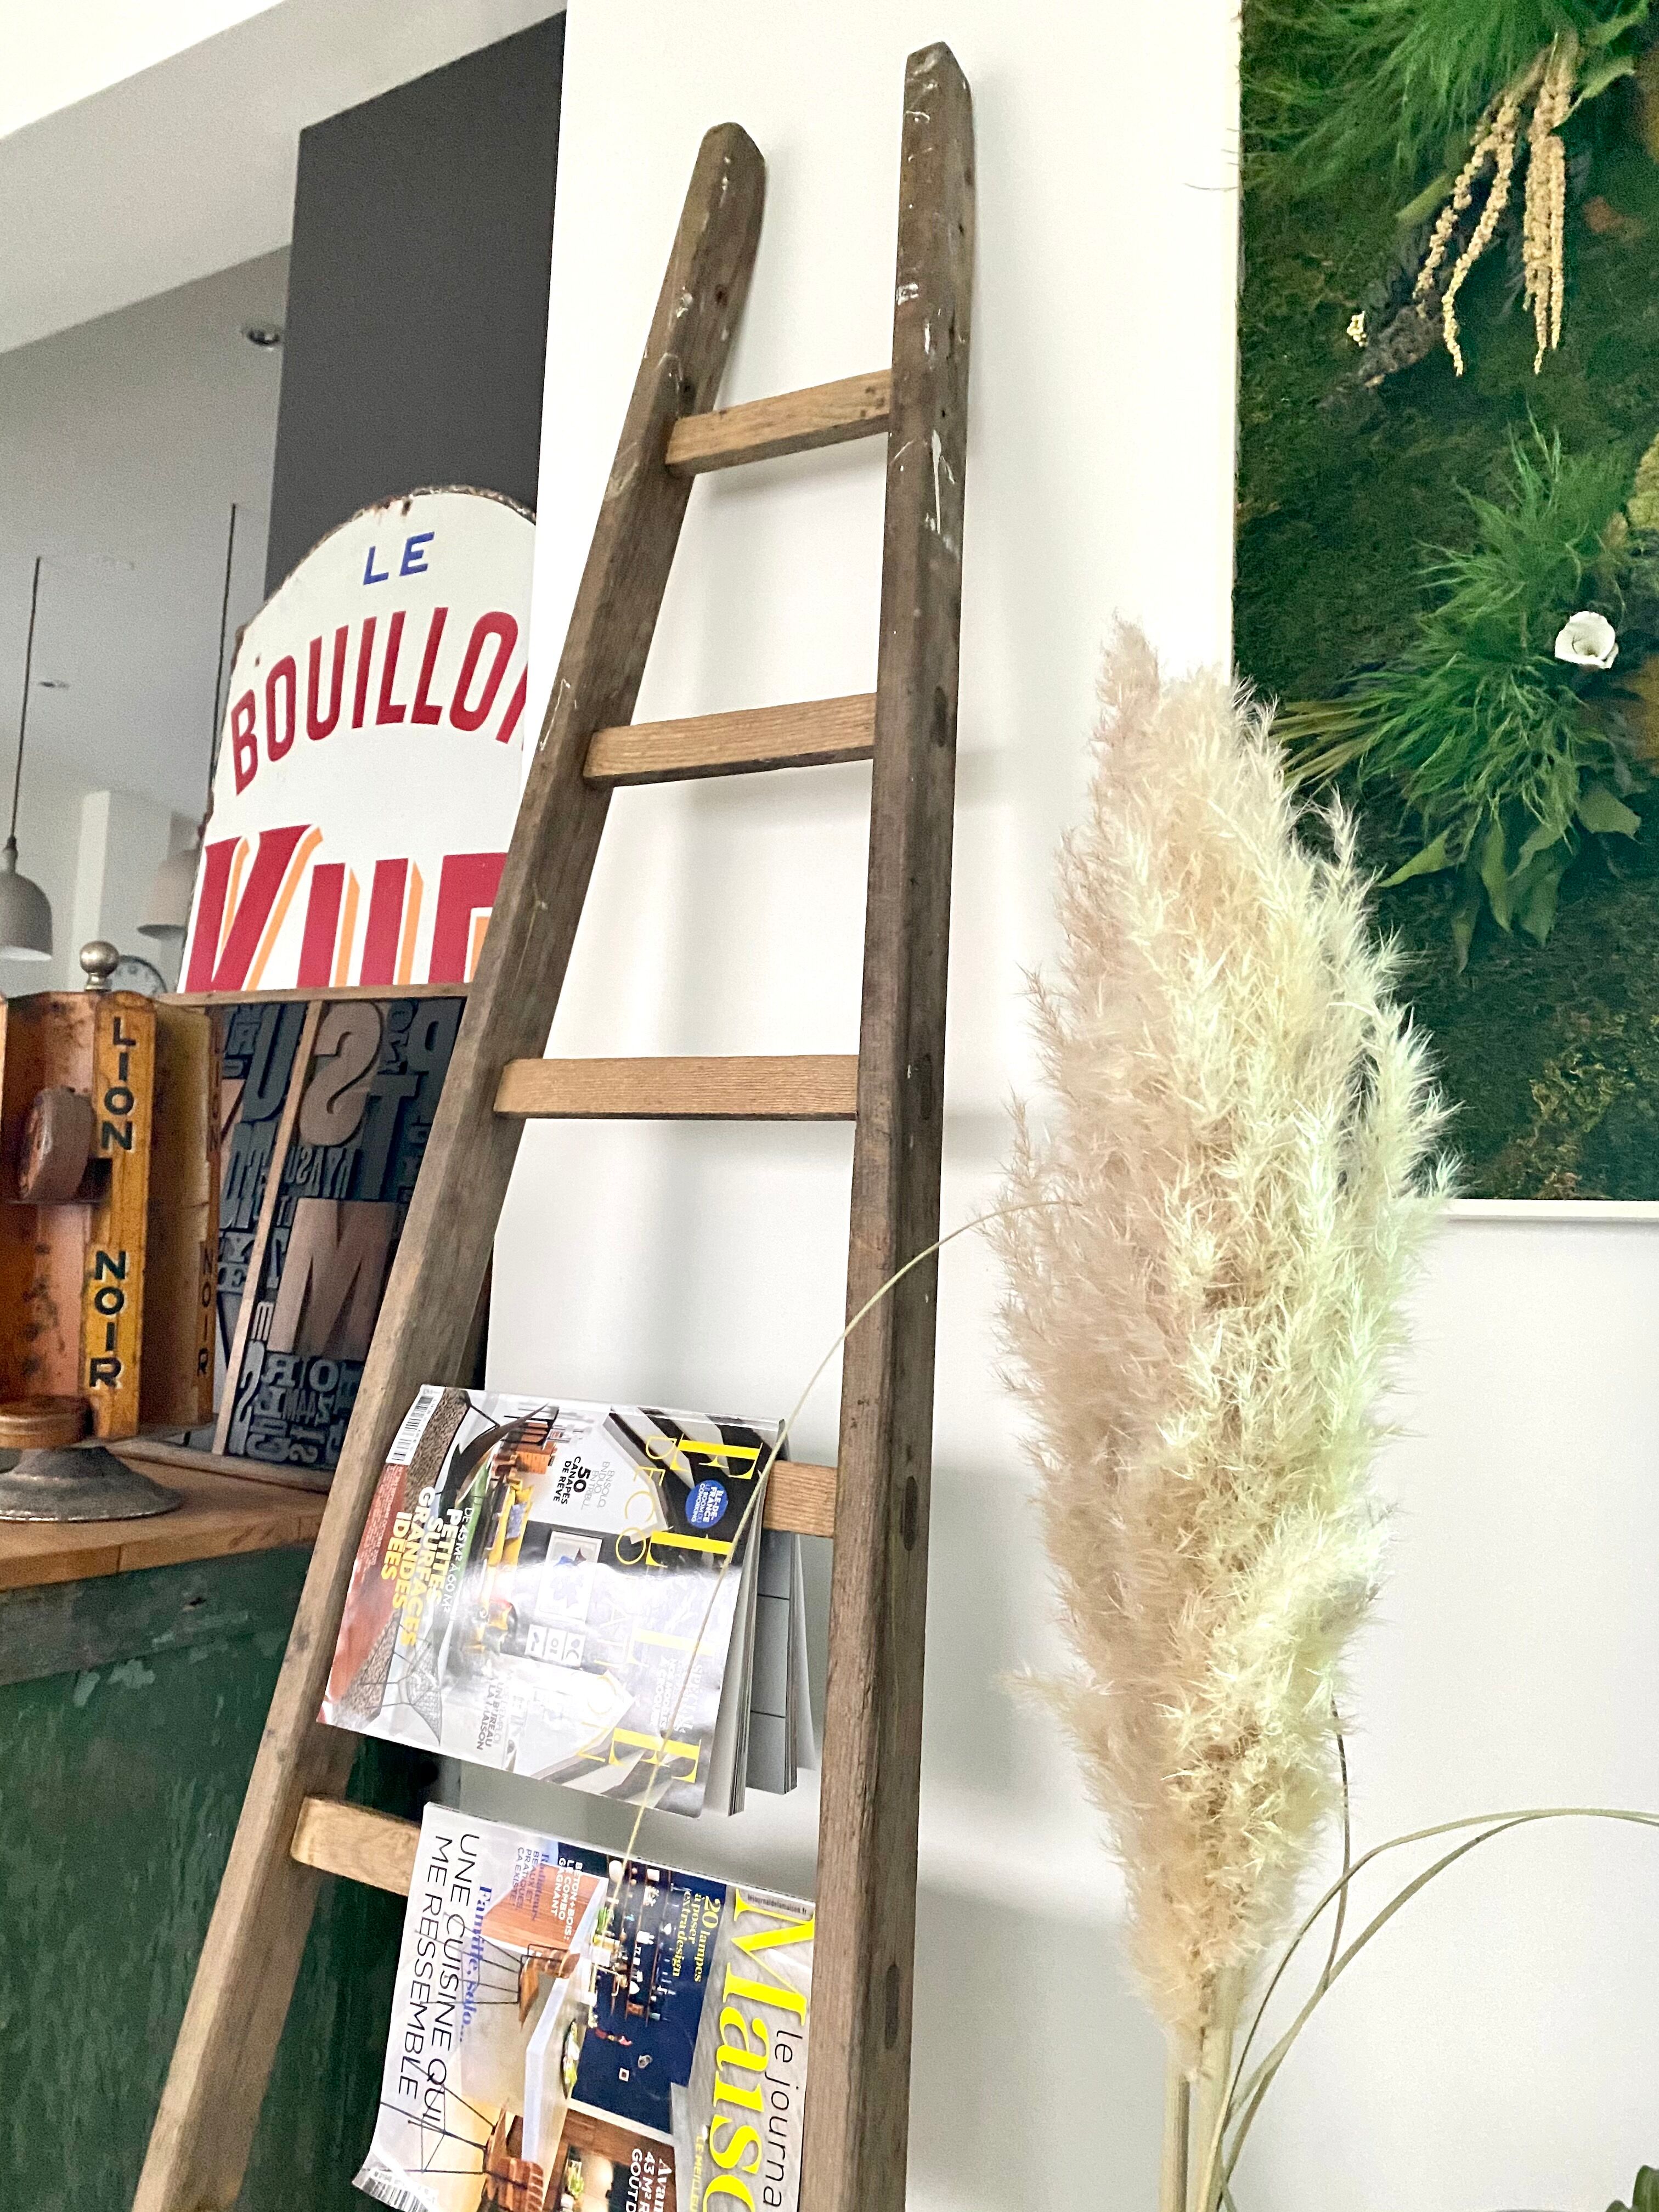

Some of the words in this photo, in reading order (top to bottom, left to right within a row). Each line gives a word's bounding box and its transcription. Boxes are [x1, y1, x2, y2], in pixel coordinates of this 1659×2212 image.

[362, 531, 435, 586] LE
[101, 1017, 137, 1150] LION
[89, 1250, 126, 1387] NOIR
[562, 1460, 572, 1473] DE
[573, 1466, 591, 1493] 50
[590, 1470, 600, 1481] EN
[600, 1462, 611, 1472] EN
[605, 1470, 616, 1482] EN
[461, 1508, 475, 1522] DE
[691, 1483, 706, 1522] COWORKING
[696, 1513, 703, 1523] DU
[698, 1492, 709, 1513] BOOM
[702, 1487, 718, 1523] FRANCE
[392, 1487, 436, 1609] GRANDES
[458, 1524, 469, 1541] 45
[425, 1509, 464, 1605] PETITES
[400, 1516, 444, 1646] SURFACES
[445, 1574, 458, 1592] 60
[575, 1436, 678, 1763] DECOATION
[427, 1836, 453, 1886] ME
[450, 1833, 479, 1906] UNE
[528, 1850, 540, 1887] BEAUX
[566, 1860, 575, 1874] LE
[551, 1858, 566, 1916] GAGNANT
[558, 1876, 572, 1921] COMBO
[679, 1891, 692, 1929] extra
[688, 1903, 701, 1944] poser
[702, 1895, 721, 1928] 20
[672, 1931, 687, 1977] design
[694, 1930, 711, 1983] lampes
[399, 1893, 443, 2100] RESSEMBLE
[432, 1914, 465, 2051] CUISINE
[775, 2029, 803, 2063] le
[422, 2058, 447, 2121] QUI
[644, 2152, 656, 2175] 43
[696, 2136, 704, 2153] LE
[628, 2148, 643, 2202] GOÛT
